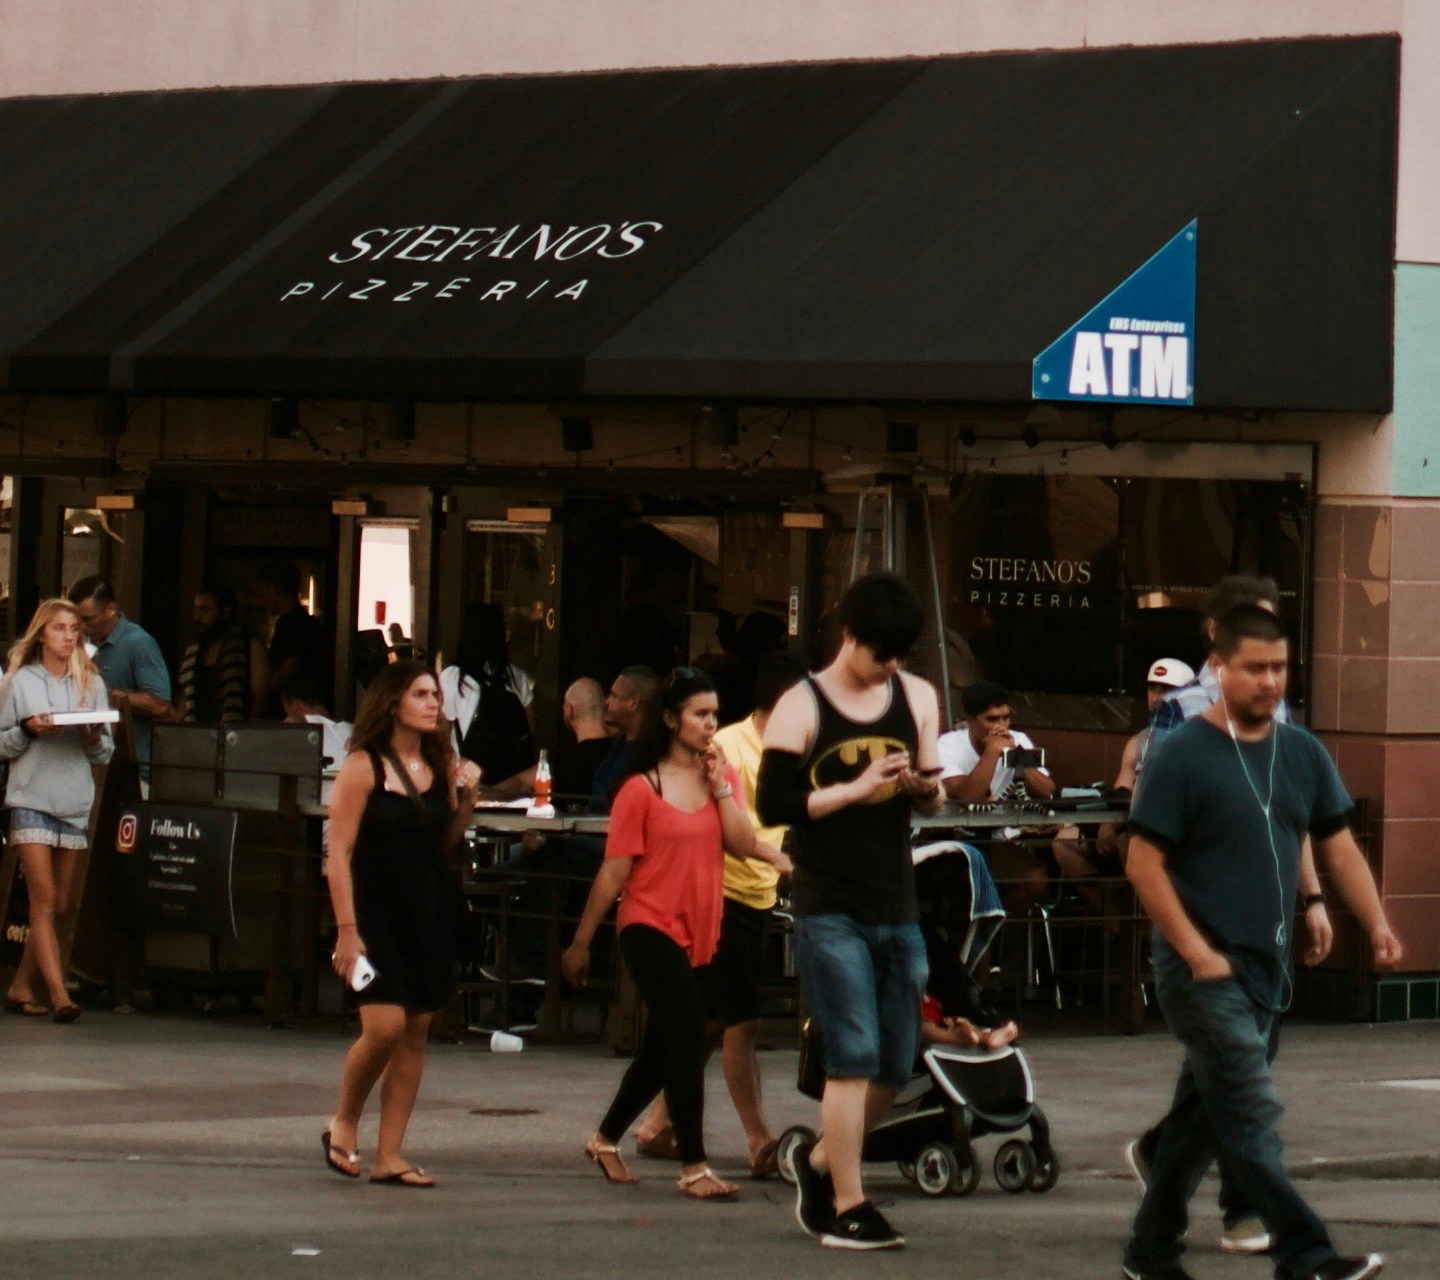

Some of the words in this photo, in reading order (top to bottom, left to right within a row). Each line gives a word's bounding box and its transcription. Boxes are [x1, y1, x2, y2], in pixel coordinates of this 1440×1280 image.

[328, 220, 663, 265] STEFANO'S
[280, 277, 590, 302] PIZZERIA
[1068, 331, 1189, 400] ATM
[970, 557, 1091, 584] STEFANO'S
[970, 590, 1090, 608] PIZZERIA
[150, 819, 185, 839] Follow
